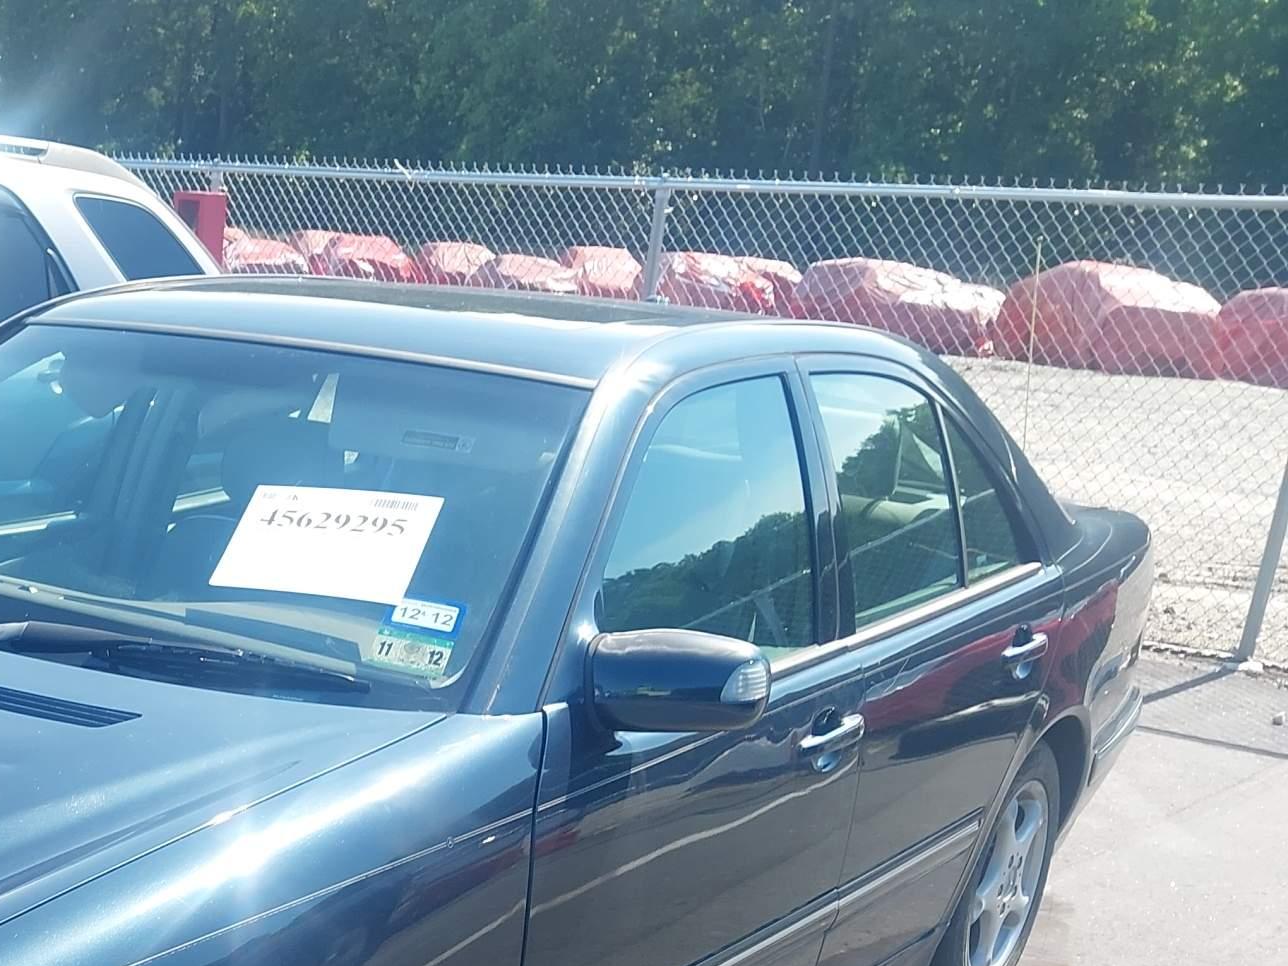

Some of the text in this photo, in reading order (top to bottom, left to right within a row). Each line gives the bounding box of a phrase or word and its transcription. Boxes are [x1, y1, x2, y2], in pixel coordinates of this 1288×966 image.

[260, 508, 408, 536] 45629295
[400, 606, 421, 621] 12
[432, 612, 454, 627] 12
[377, 640, 444, 667] 11 12
